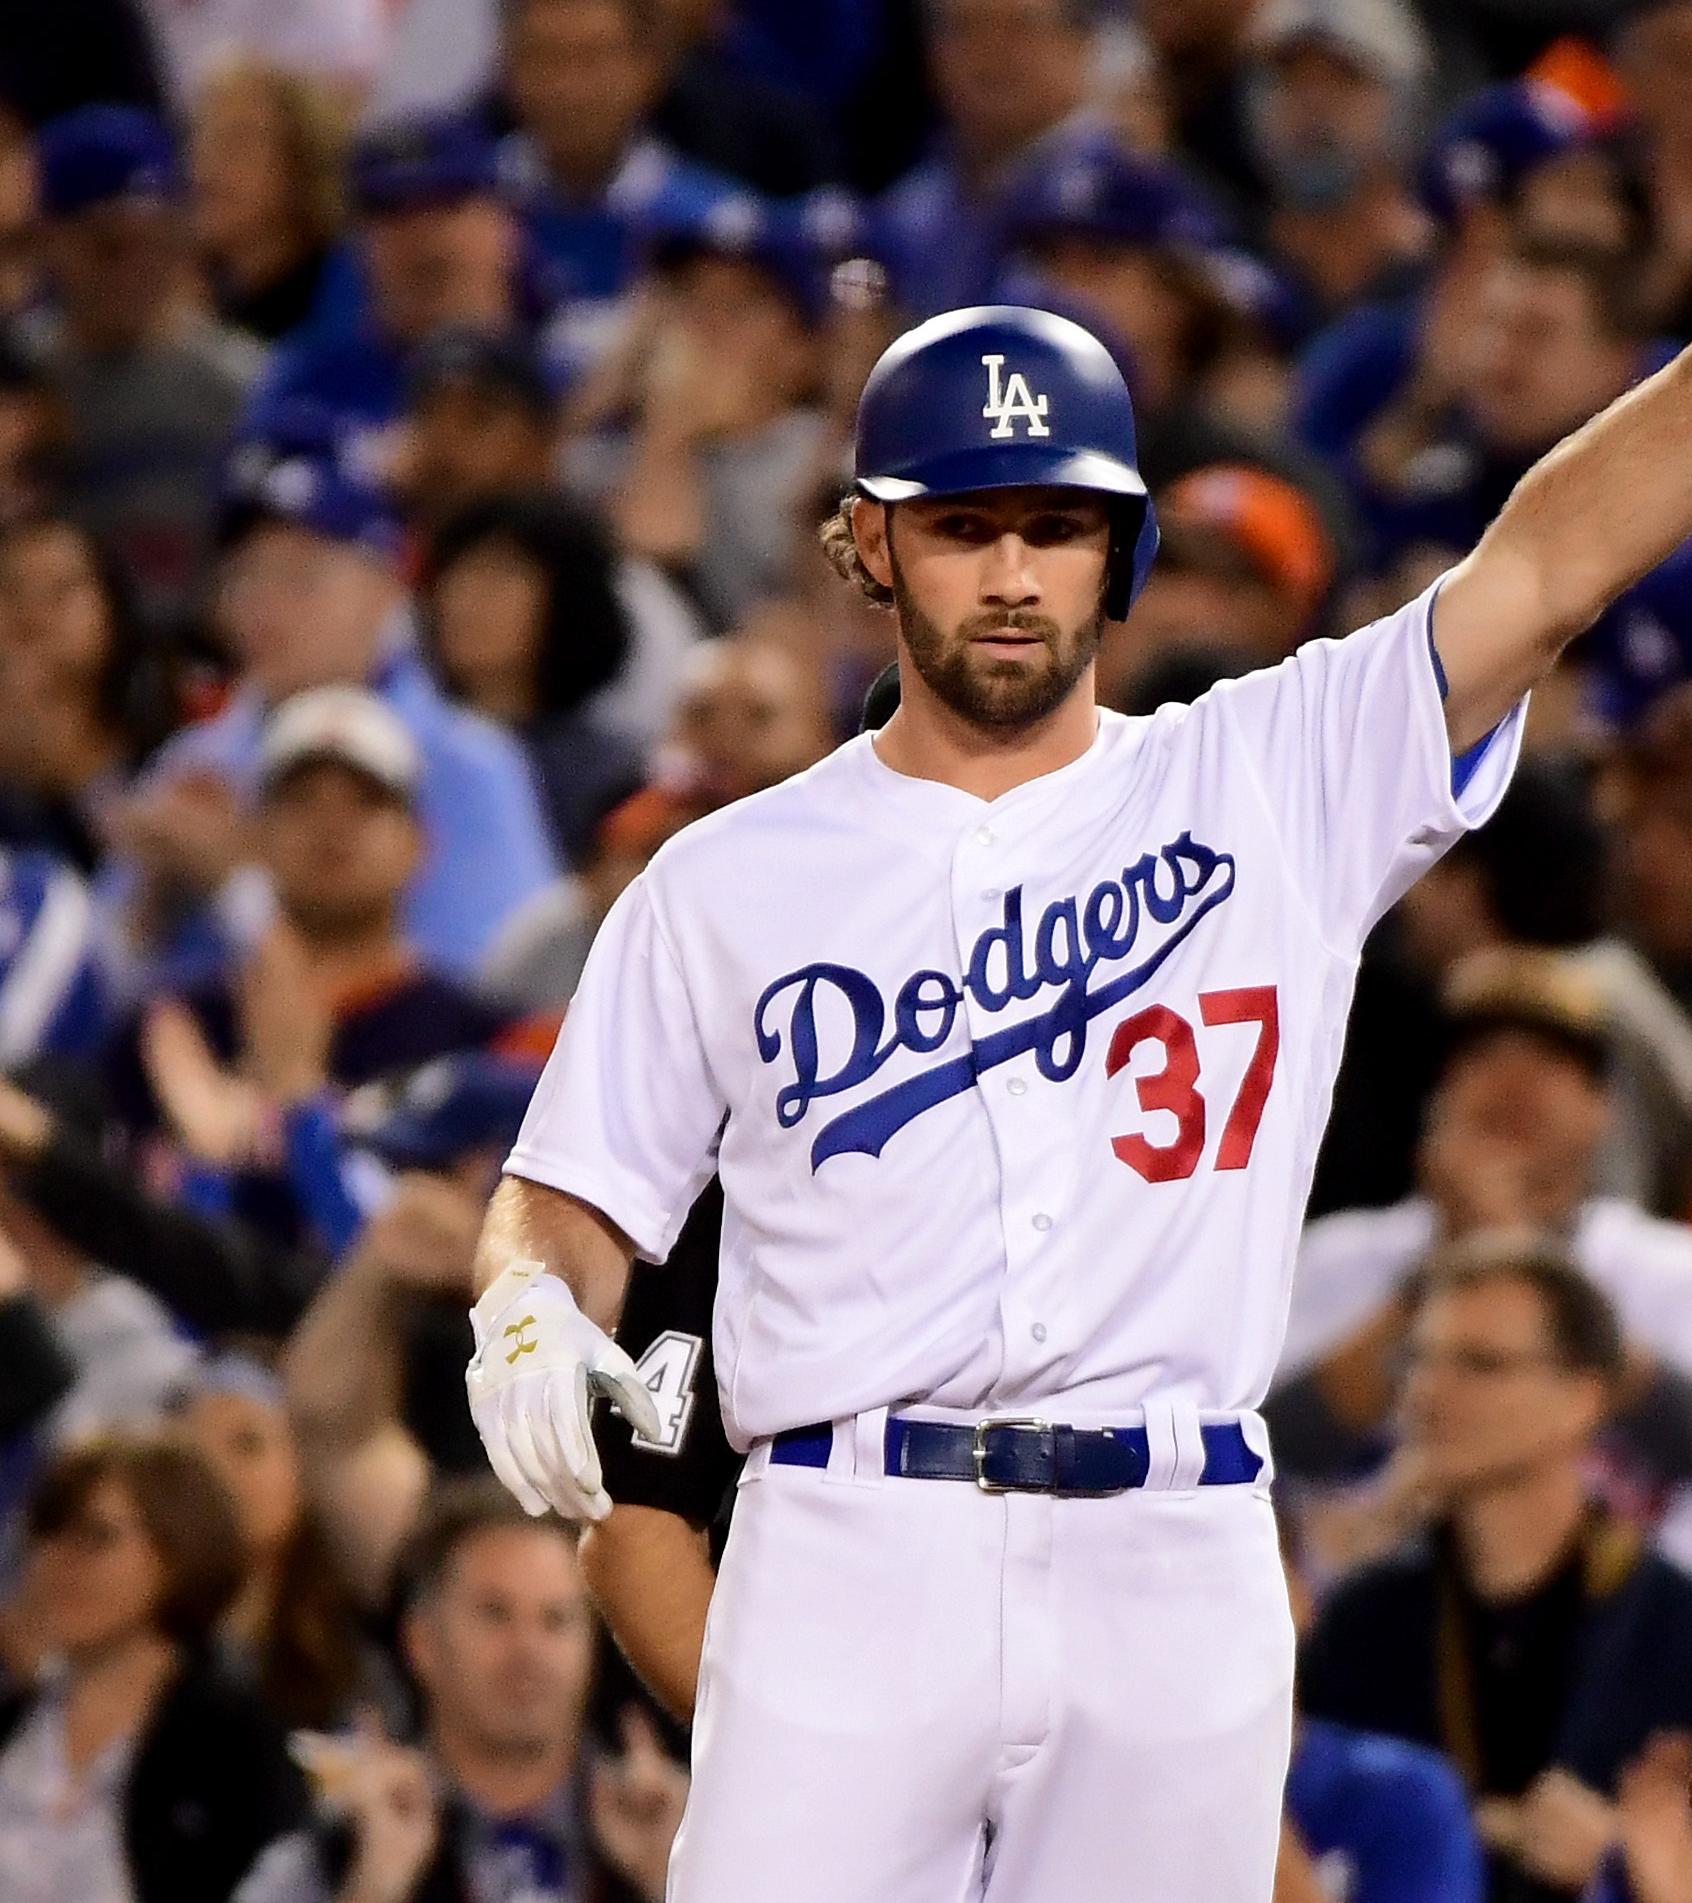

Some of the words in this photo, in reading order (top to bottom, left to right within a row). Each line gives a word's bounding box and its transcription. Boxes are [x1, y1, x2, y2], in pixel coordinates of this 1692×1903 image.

[981, 353, 1051, 439] LA
[754, 830, 1236, 1130] Dodgers
[1105, 984, 1280, 1184] 37
[609, 1329, 703, 1456] 4
